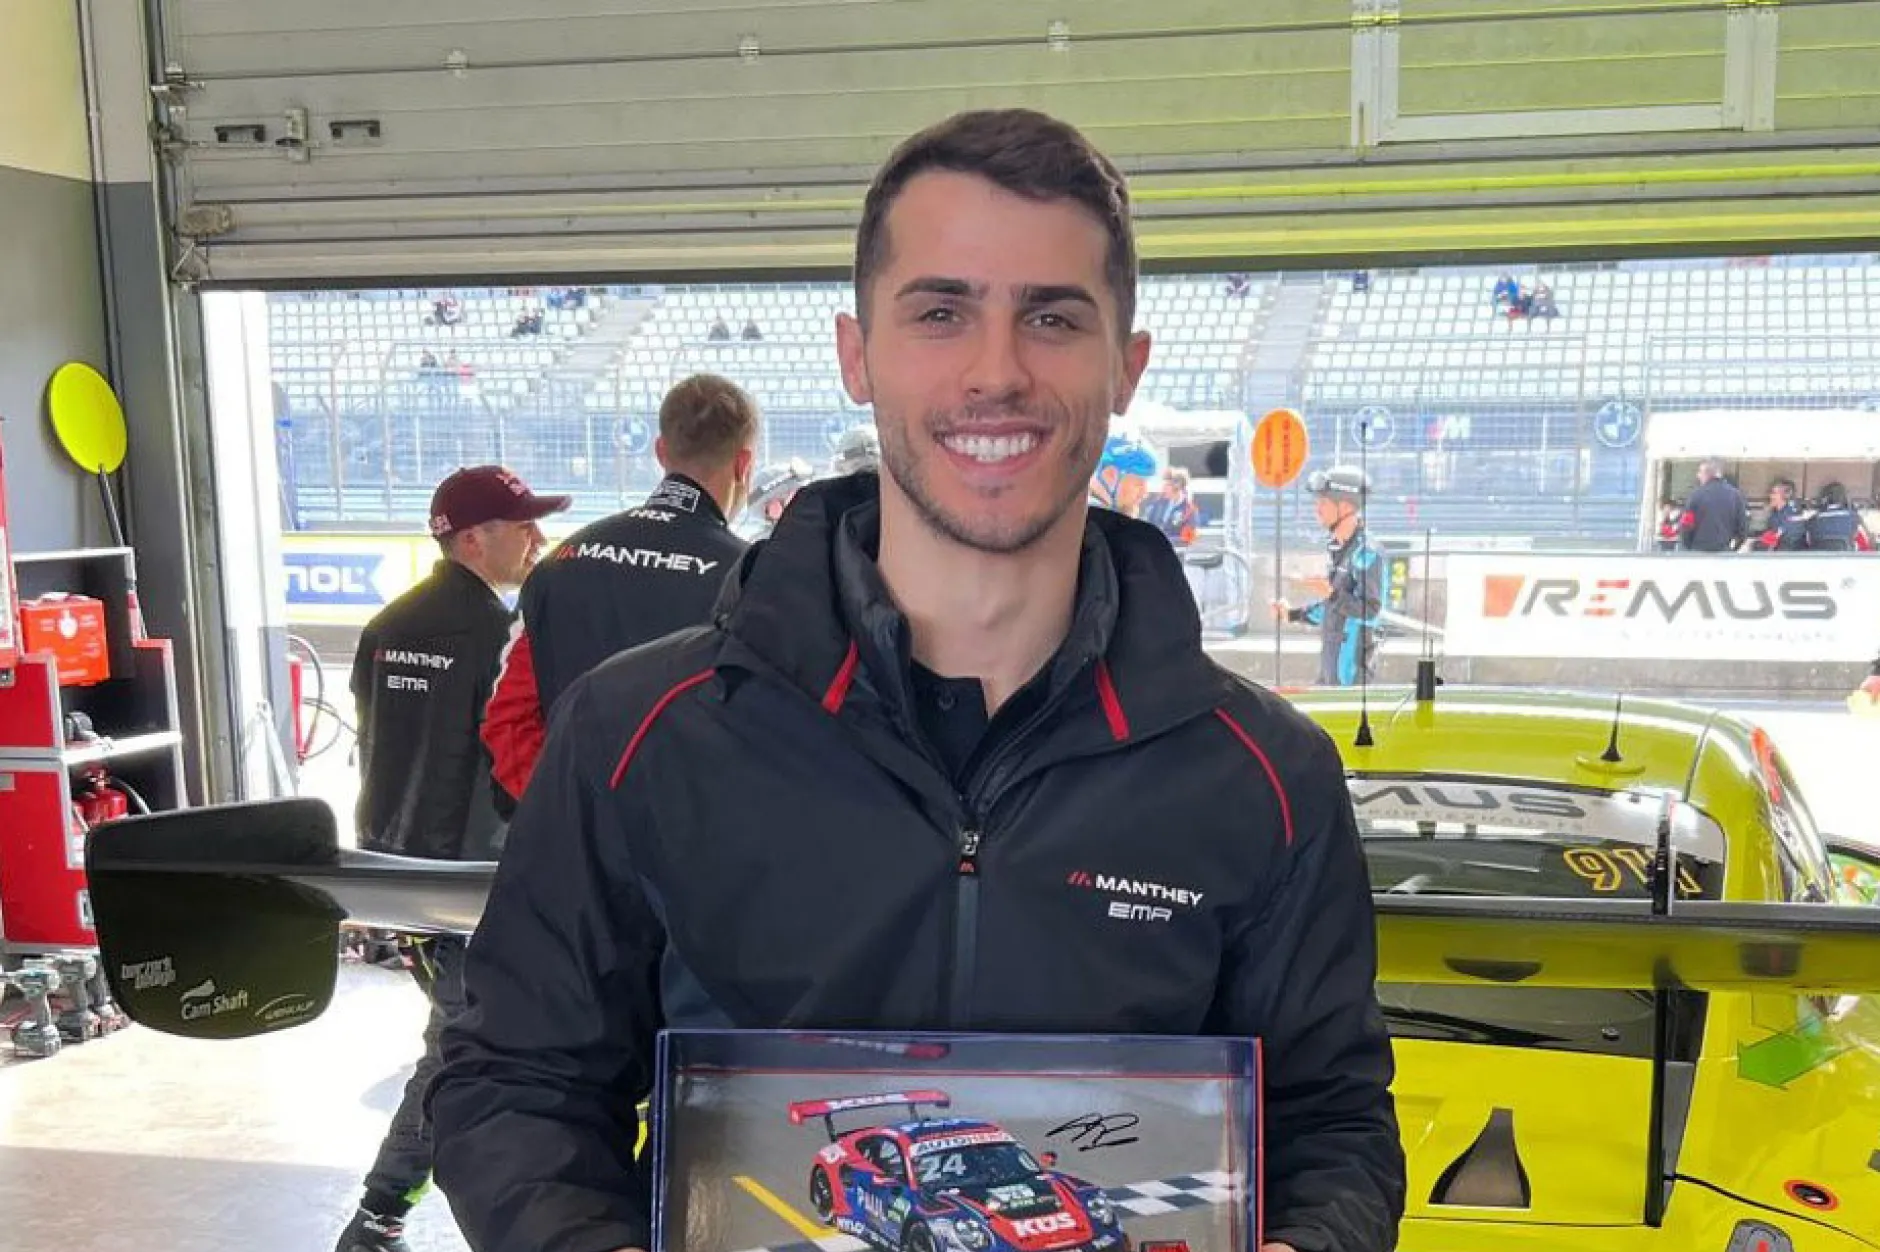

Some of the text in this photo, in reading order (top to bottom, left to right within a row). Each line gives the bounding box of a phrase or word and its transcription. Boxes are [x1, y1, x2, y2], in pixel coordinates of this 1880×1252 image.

[578, 542, 719, 575] MANTHEY
[1520, 578, 1839, 624] REMUS
[385, 649, 454, 670] MANTHEY
[1095, 873, 1203, 907] MANTHEY
[1108, 901, 1173, 922] EMA
[181, 1003, 212, 1020] Cam
[918, 1152, 967, 1184] 24
